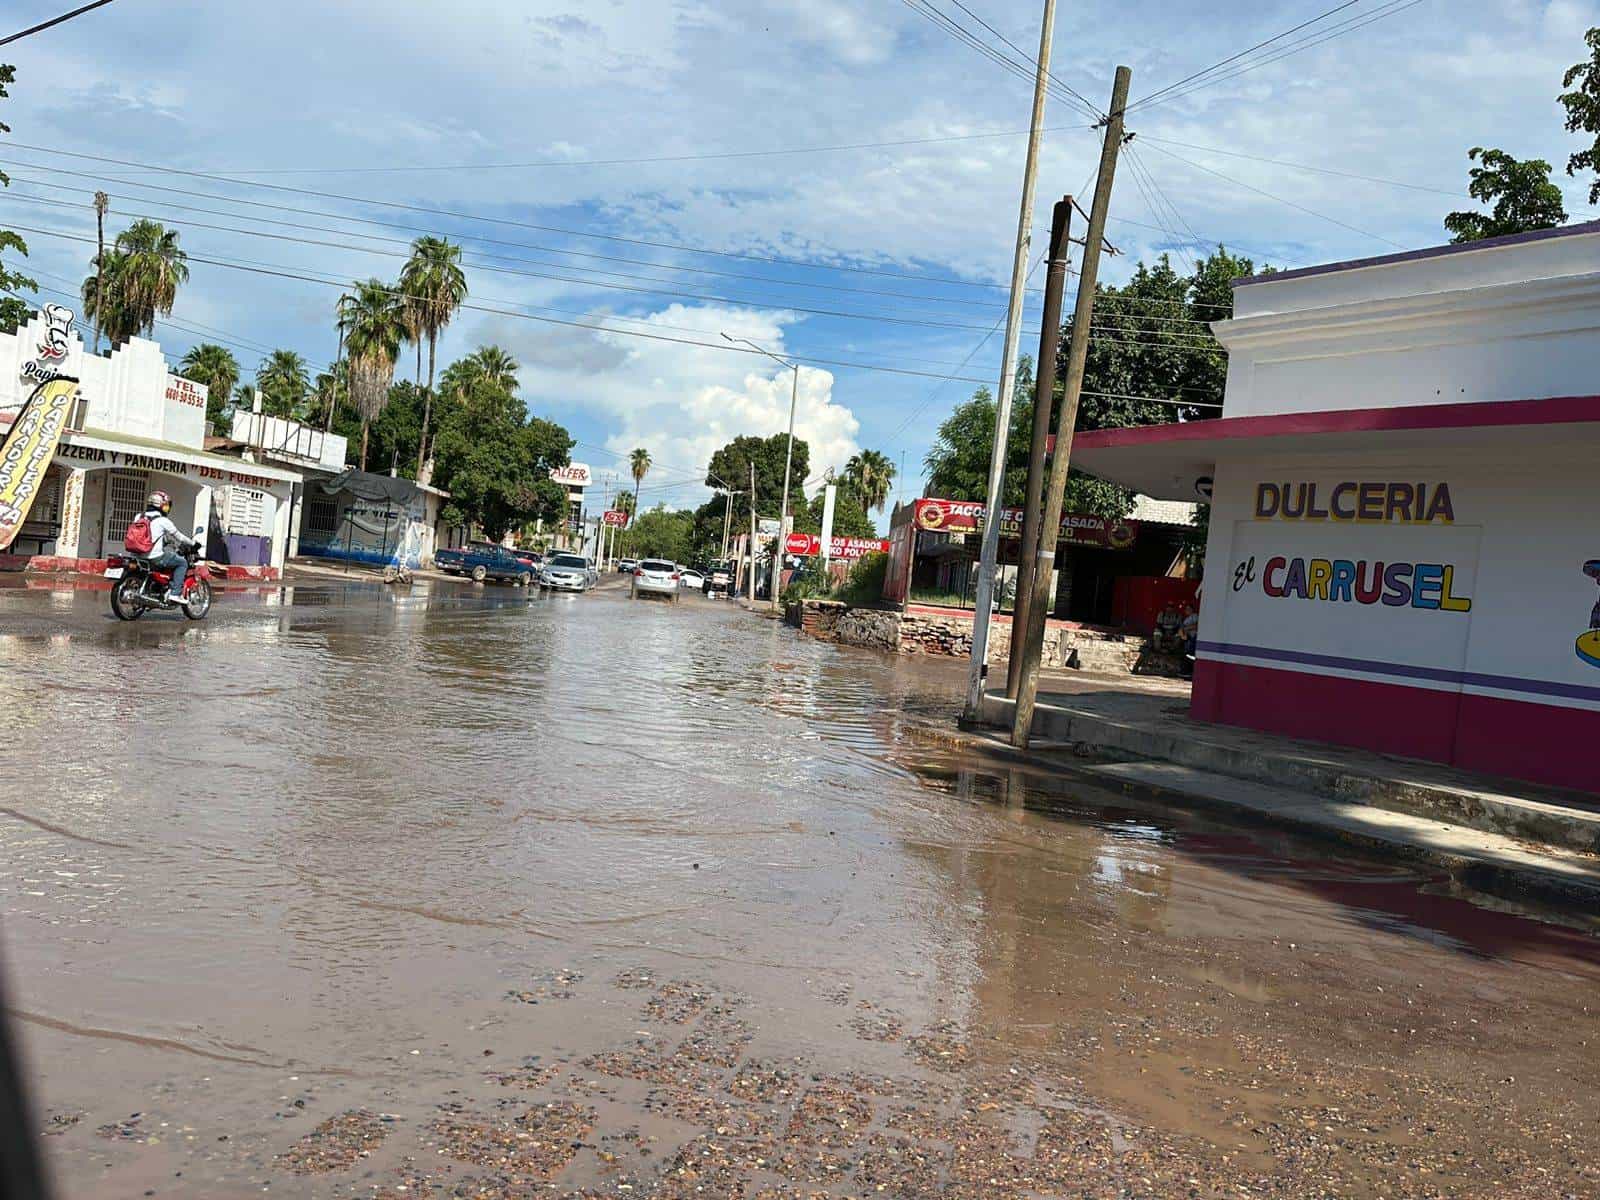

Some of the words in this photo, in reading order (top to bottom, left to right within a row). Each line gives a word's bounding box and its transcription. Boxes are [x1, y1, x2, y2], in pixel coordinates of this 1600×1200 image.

[57, 443, 105, 462] IZZERIA
[110, 451, 119, 464] Y
[124, 452, 187, 475] PANADERIA
[1256, 482, 1455, 525] DULCERIA
[977, 517, 1020, 532] EILO
[1061, 516, 1105, 530] ASADA
[847, 538, 882, 550] ASADOS
[1233, 556, 1256, 592] El
[1262, 556, 1472, 612] CARRUSEL
